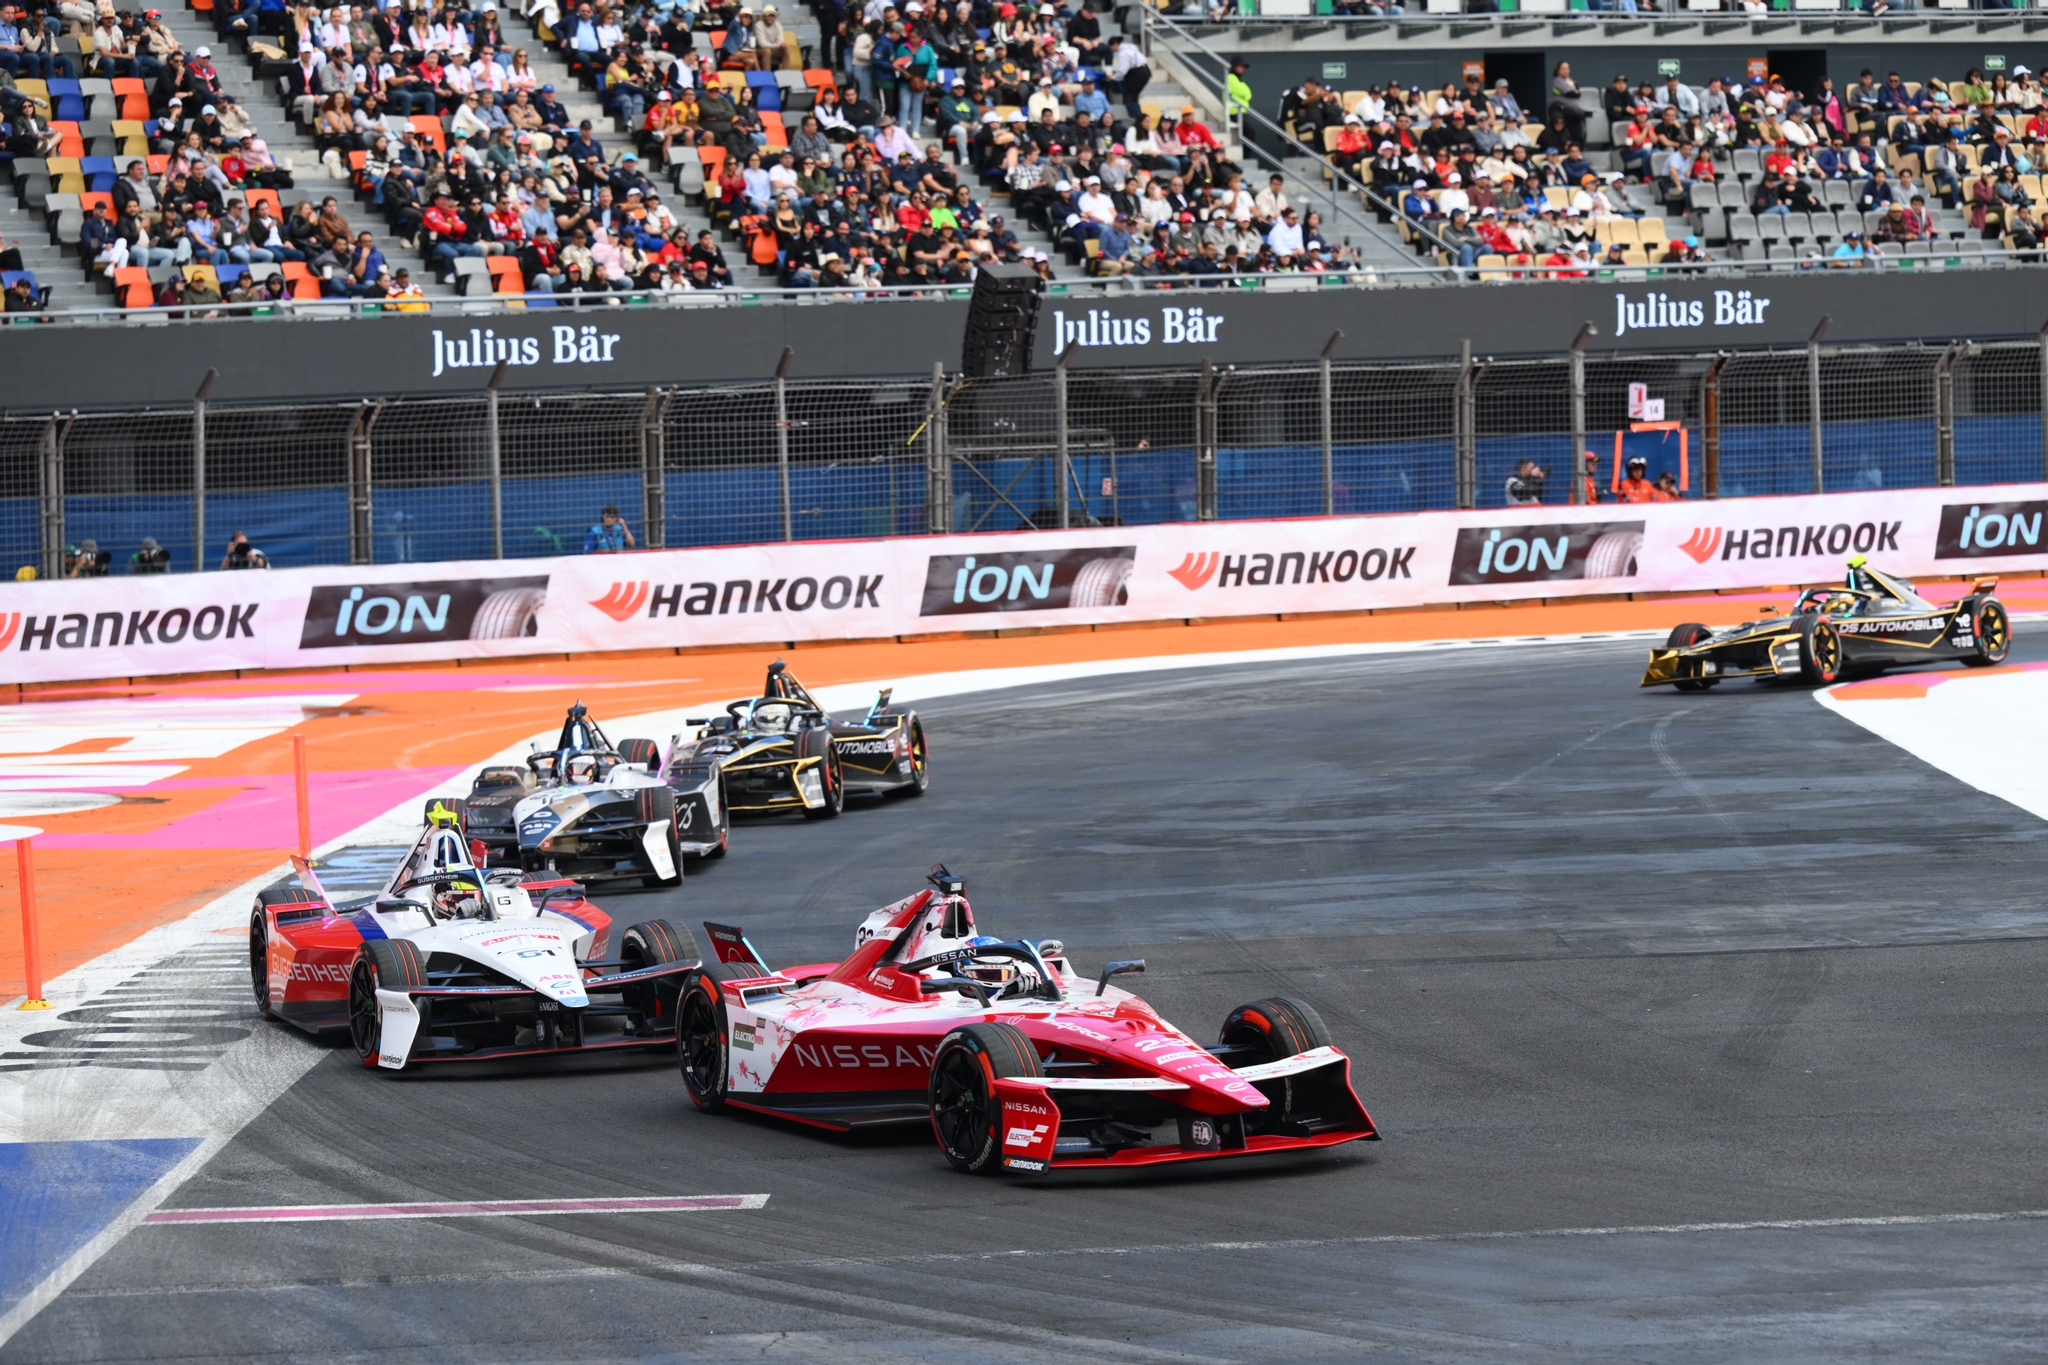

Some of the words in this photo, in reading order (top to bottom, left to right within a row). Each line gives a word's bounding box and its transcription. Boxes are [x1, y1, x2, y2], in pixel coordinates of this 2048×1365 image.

[1615, 292, 1704, 337] Julius
[1713, 290, 1770, 325] Bär
[1053, 309, 1151, 355] Julius
[1162, 307, 1224, 343] Bär
[432, 328, 540, 377] Julius
[552, 325, 620, 363] Bär
[1649, 406, 1659, 415] 14
[1859, 617, 1945, 633] AUTOMOBILES
[517, 949, 556, 959] 51
[931, 949, 977, 963] NISSAN
[272, 953, 351, 982] GUGGENHEI
[1134, 1037, 1192, 1052] 23
[1005, 1101, 1047, 1115] NISSAN
